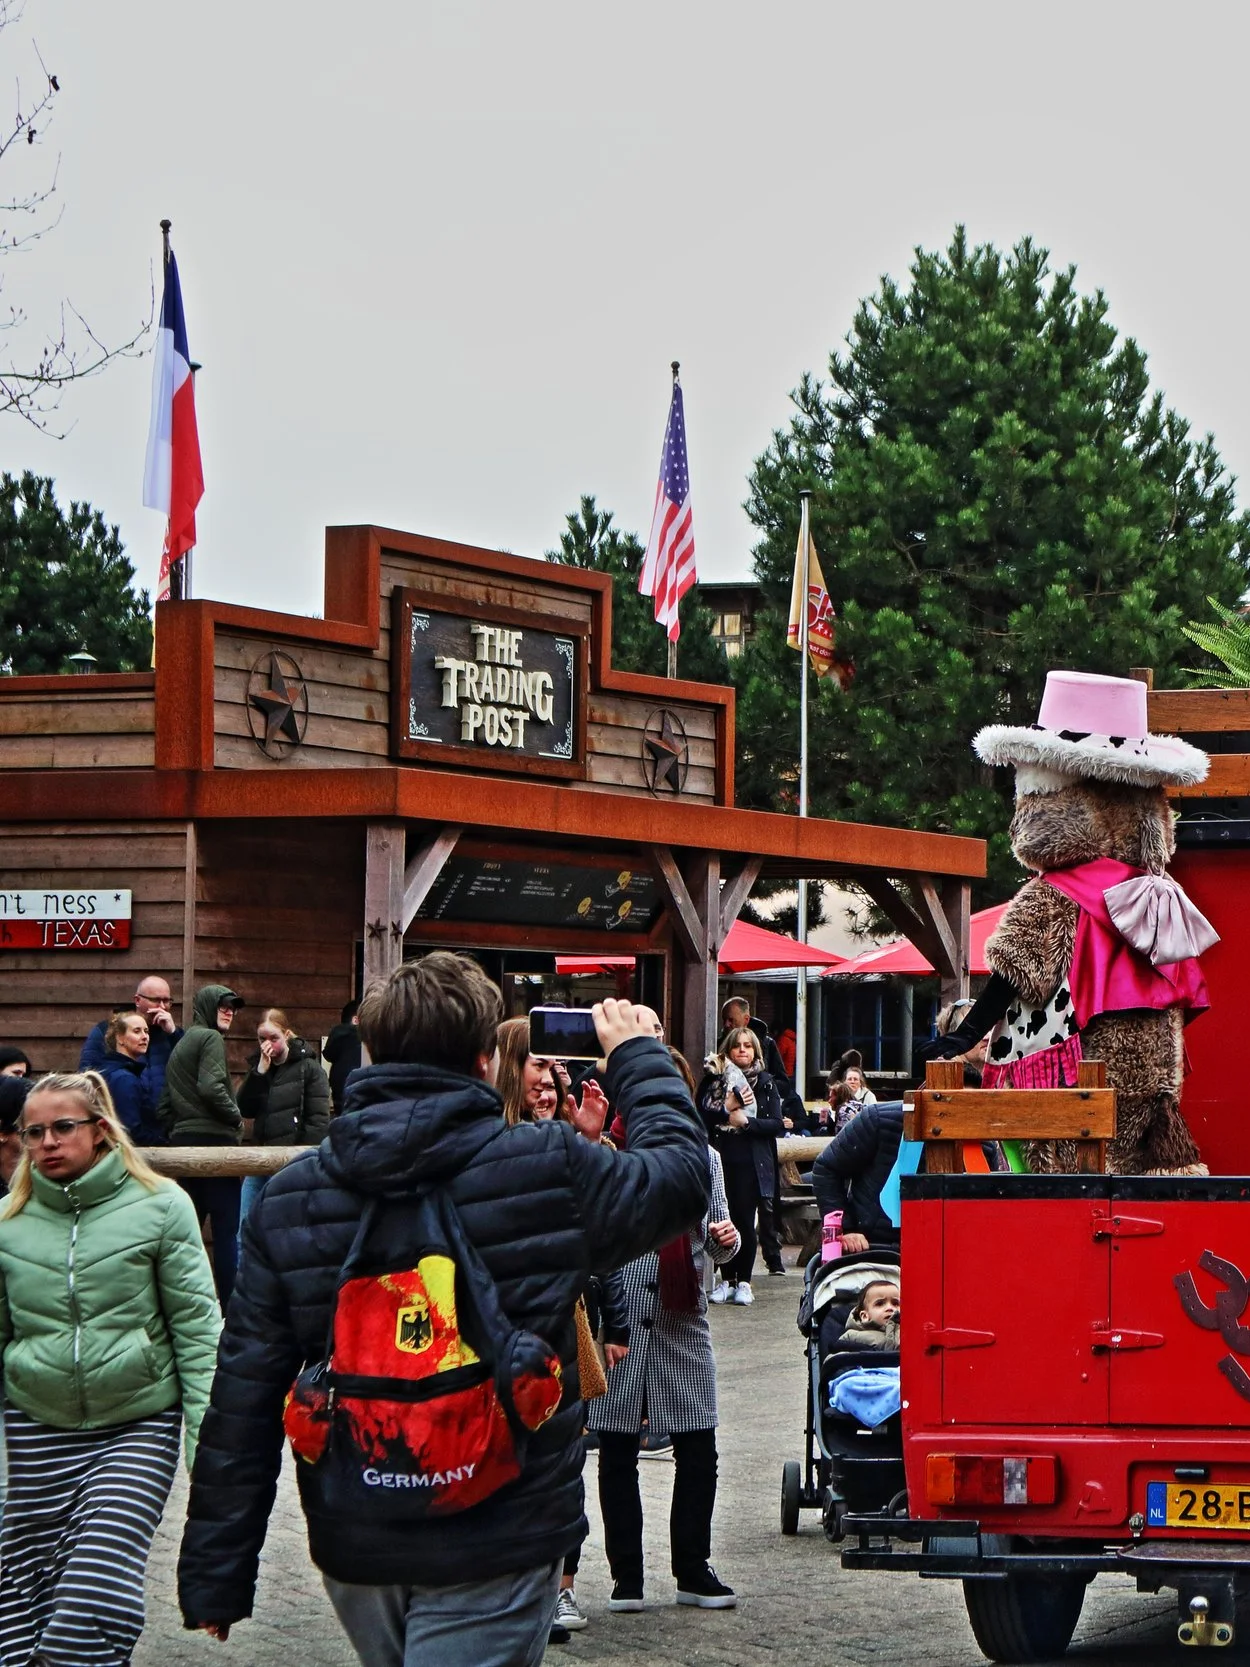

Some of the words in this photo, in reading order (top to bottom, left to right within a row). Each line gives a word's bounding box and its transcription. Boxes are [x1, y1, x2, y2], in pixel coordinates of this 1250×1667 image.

[471, 624, 523, 668] THE
[435, 656, 554, 725] TRADING
[461, 703, 530, 748] POST
[37, 921, 116, 947] TEXAS
[363, 1463, 475, 1488] GERMANY
[1150, 1508, 1164, 1518] NL
